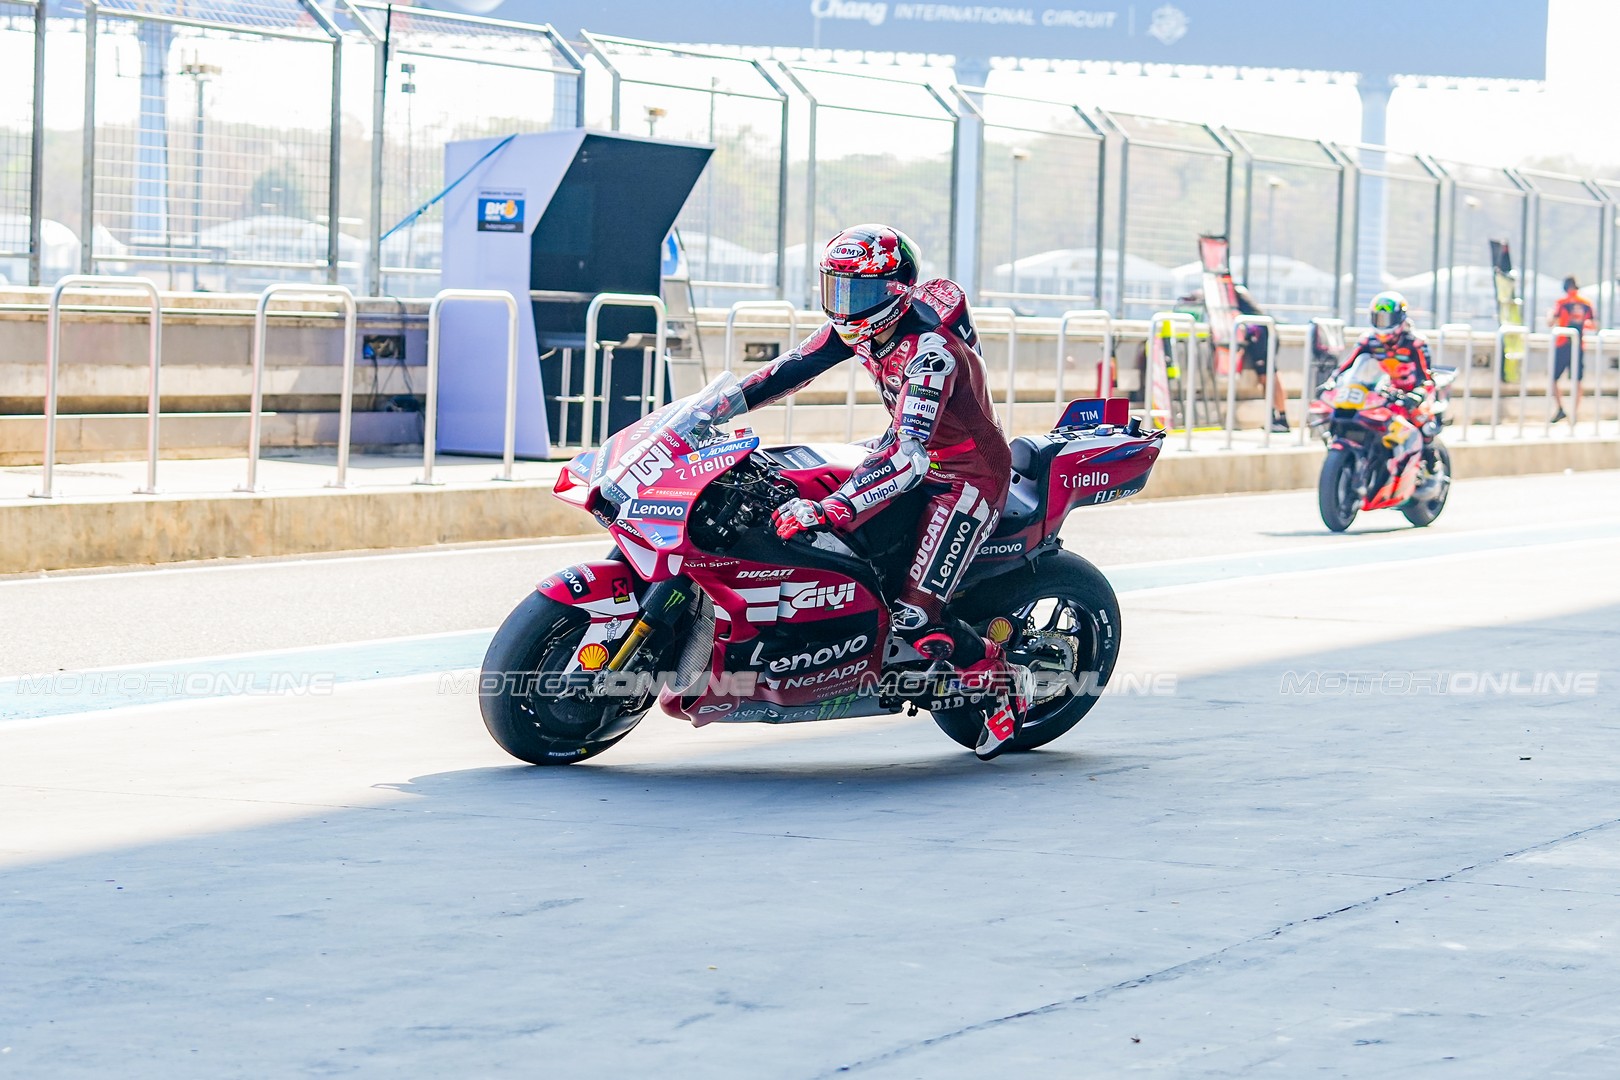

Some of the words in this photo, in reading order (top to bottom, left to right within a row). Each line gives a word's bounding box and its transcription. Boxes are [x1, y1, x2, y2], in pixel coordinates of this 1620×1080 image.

[810, 0, 888, 26] Chang
[894, 3, 1036, 26] INTERNATIONAL
[1041, 9, 1117, 28] CIRCUIT
[896, 284, 908, 292] 63
[873, 308, 900, 328] Lenovo
[875, 341, 896, 359] Lenovo
[913, 402, 936, 414] riello
[1079, 410, 1099, 422] TIM
[706, 439, 753, 457] ADVANCE
[575, 463, 590, 474] TIM
[691, 455, 735, 477] riello
[855, 464, 891, 487] Lenovo
[1072, 472, 1109, 488] riello
[863, 480, 898, 505] Unipol
[631, 503, 684, 517] Lenovo
[650, 531, 667, 547] TIM
[909, 505, 950, 581] DUCATI
[709, 560, 740, 568] Sport
[931, 521, 971, 589] Lenovo
[736, 568, 796, 579] DUCATI
[791, 582, 856, 610] GIVI
[750, 635, 868, 673] Lenovo
[784, 659, 868, 690] NetApp
